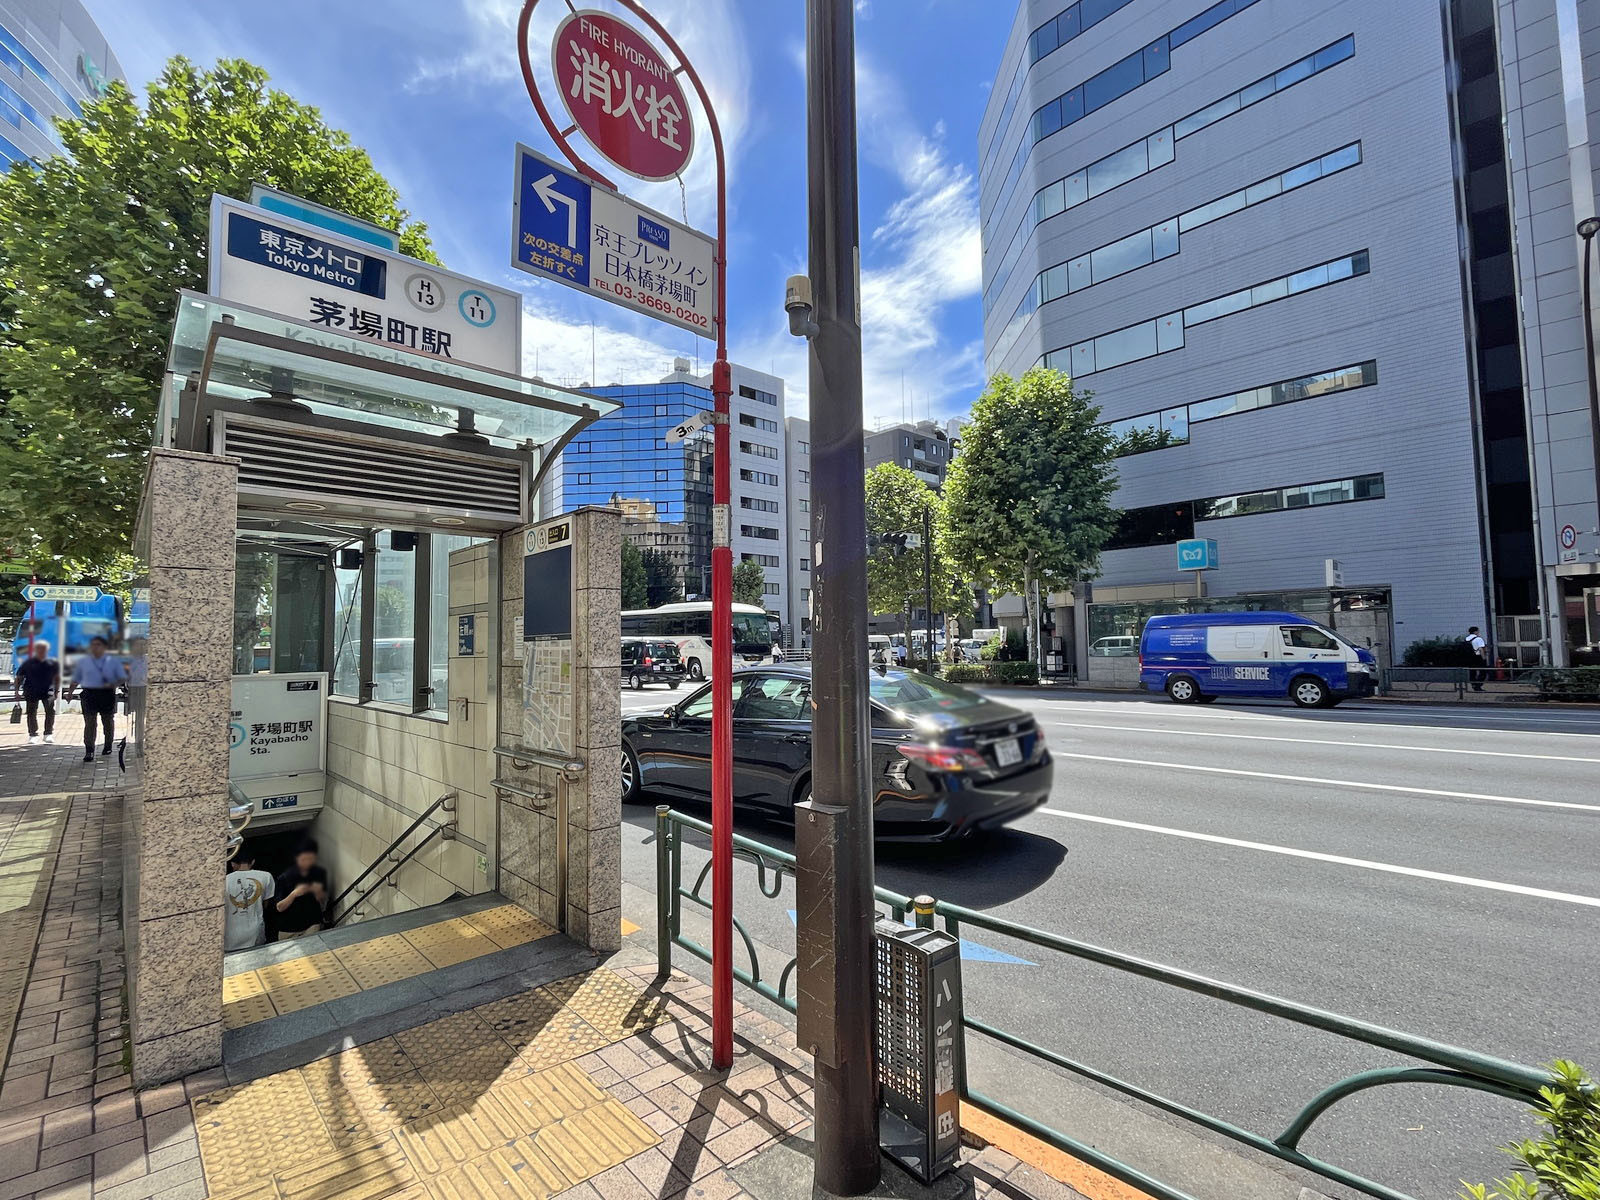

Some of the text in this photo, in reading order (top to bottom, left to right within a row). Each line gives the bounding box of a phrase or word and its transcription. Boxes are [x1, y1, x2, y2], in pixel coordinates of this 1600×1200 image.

[580, 18, 670, 83] FIRE HYDRANT
[569, 39, 683, 152] 消火栓
[259, 228, 362, 274] 東京メトロ
[523, 231, 584, 267] 次の交差点
[593, 223, 708, 287] 京王プレッソイン
[265, 249, 356, 287] Tokyo Metro
[529, 251, 577, 279] 左折すぐ
[420, 279, 431, 292] H
[605, 252, 698, 308] 日本橋茅場町
[416, 290, 435, 306] 13
[474, 296, 481, 307] T
[469, 307, 485, 321] 11
[309, 296, 453, 358] 茅場町駅
[675, 424, 695, 438] 3m
[561, 525, 567, 539] 7
[1234, 666, 1270, 680] SERVICE
[308, 681, 315, 690] 7
[250, 720, 313, 737] 茅場町駅
[250, 734, 309, 746] Kayabacho
[250, 746, 271, 755] Sta.
